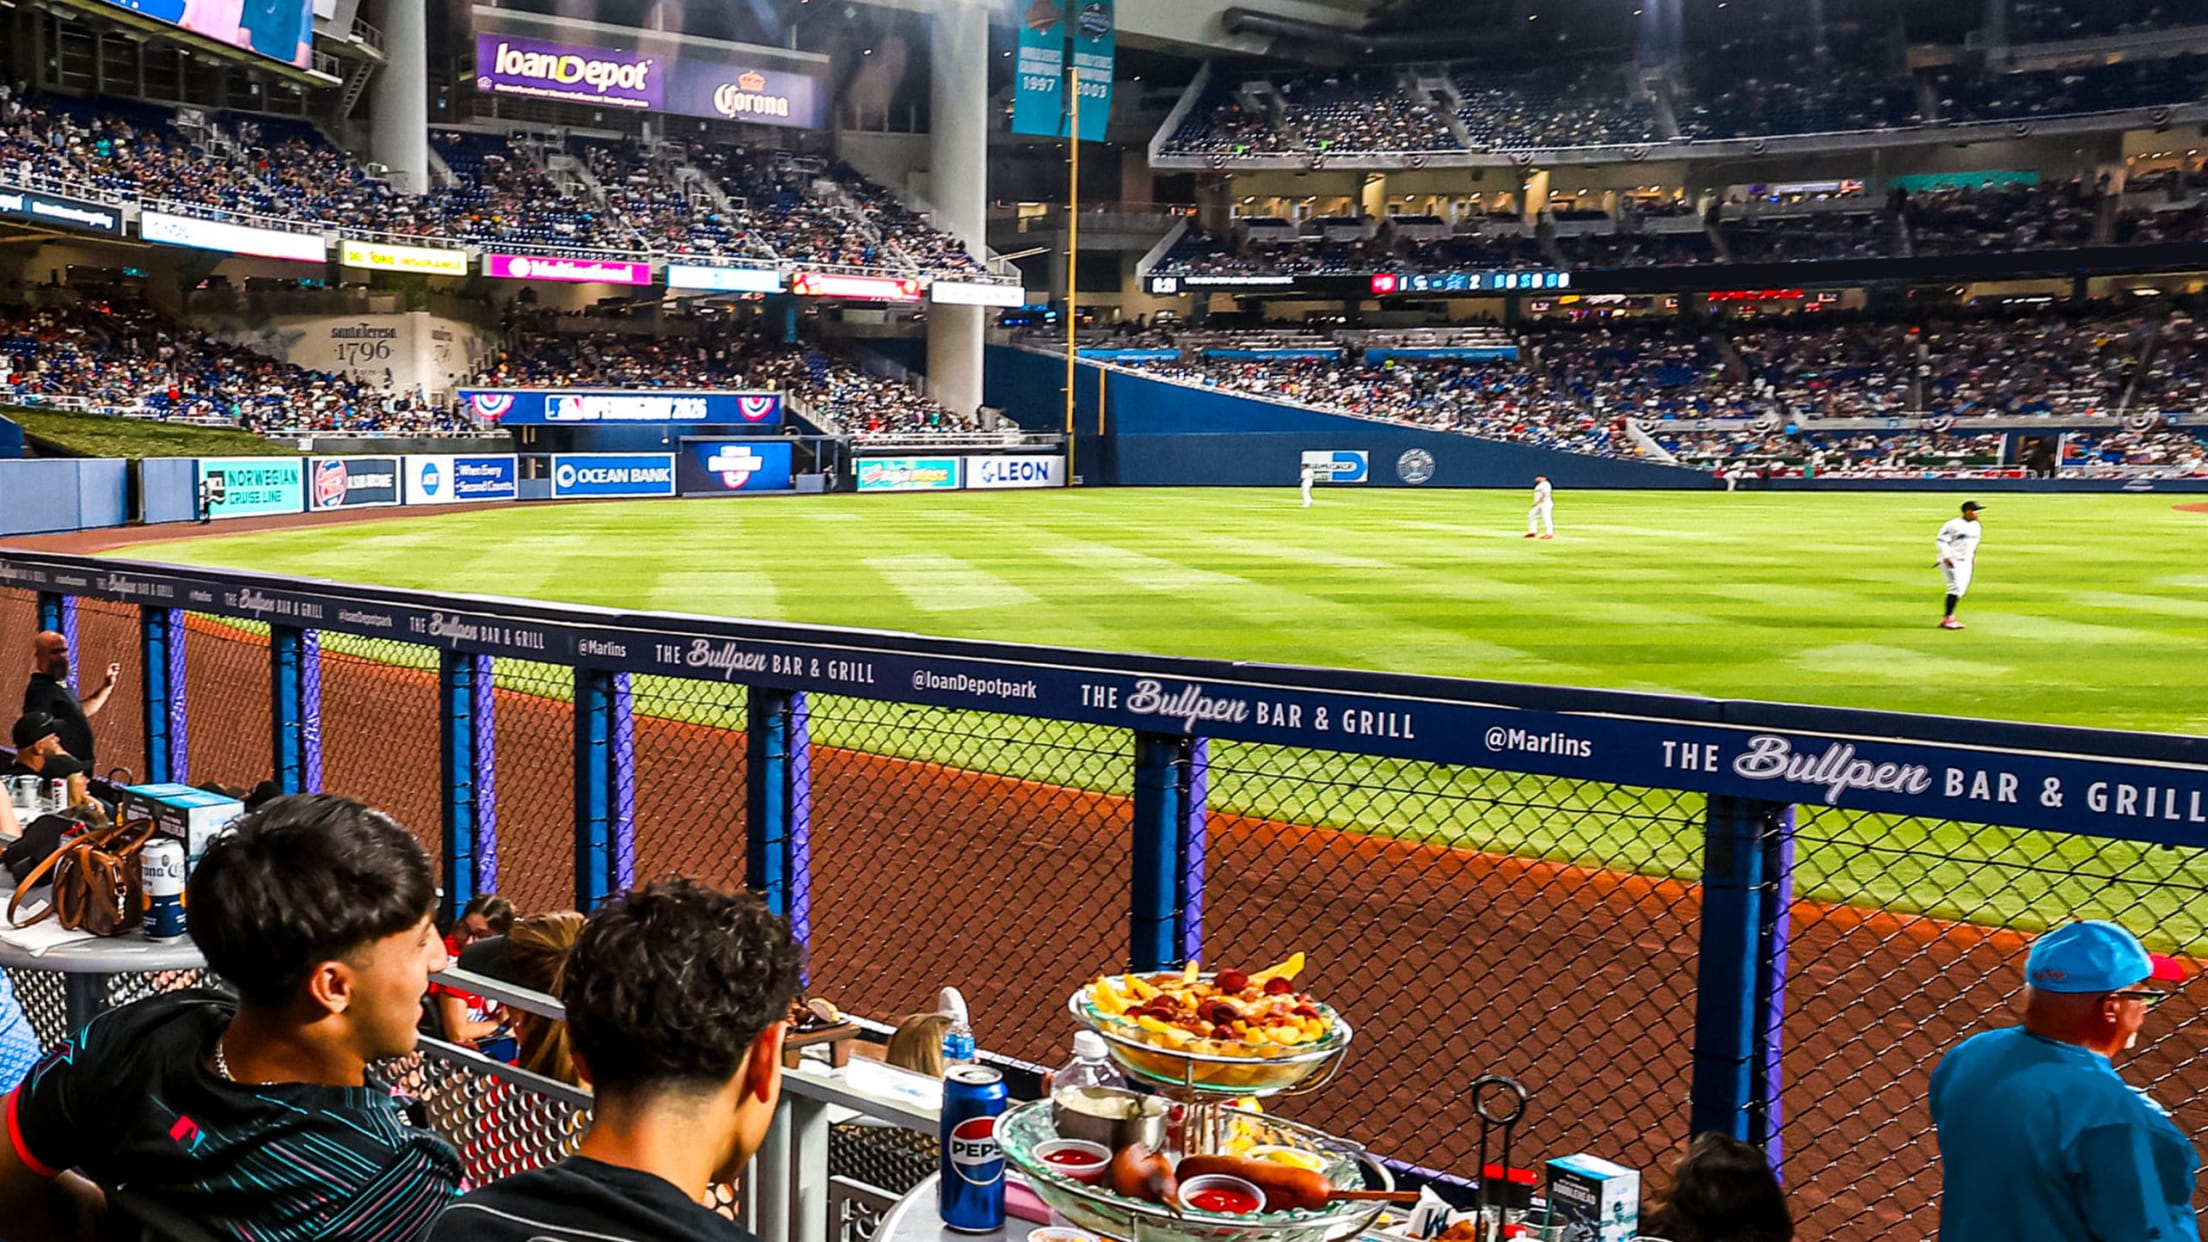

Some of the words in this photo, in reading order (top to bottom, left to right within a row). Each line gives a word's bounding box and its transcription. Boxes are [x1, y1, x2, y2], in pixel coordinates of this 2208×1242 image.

[495, 42, 648, 93] loanDepot
[1023, 76, 1056, 92] 1997
[714, 83, 788, 119] Corona
[336, 340, 391, 366] 1796
[227, 469, 298, 487] NORWEGIAN
[577, 468, 629, 484] OCEAN
[632, 466, 670, 483] BANK
[998, 462, 1049, 481] LEON
[229, 490, 261, 505] CRUISE
[263, 489, 283, 503] LINE
[302, 602, 323, 619] GRILL
[410, 616, 426, 634] THE
[428, 612, 478, 648] Bullpen
[481, 628, 501, 644] BAR
[504, 630, 511, 645] &
[515, 630, 545, 649] GRILL
[578, 639, 627, 657] @Marlins
[656, 644, 681, 665] THE
[687, 638, 768, 680] Bullpen
[773, 655, 803, 677] BAR
[811, 658, 820, 677] &
[828, 659, 874, 684] GRILL
[913, 670, 1037, 699] @loanDepotpark
[1081, 684, 1118, 709] THE
[1127, 680, 1249, 734] Bullpen
[1256, 701, 1302, 728] BAR
[1315, 706, 1329, 731] &
[1343, 709, 1415, 739] GRILL
[1484, 726, 1592, 758] @Marlins
[1662, 741, 1719, 772] THE
[1733, 734, 1932, 806] Bullpen
[1944, 768, 2018, 803] BAR
[2040, 777, 2063, 808] &
[2086, 782, 2207, 823] GRILL
[952, 1141, 1002, 1158] PEPS
